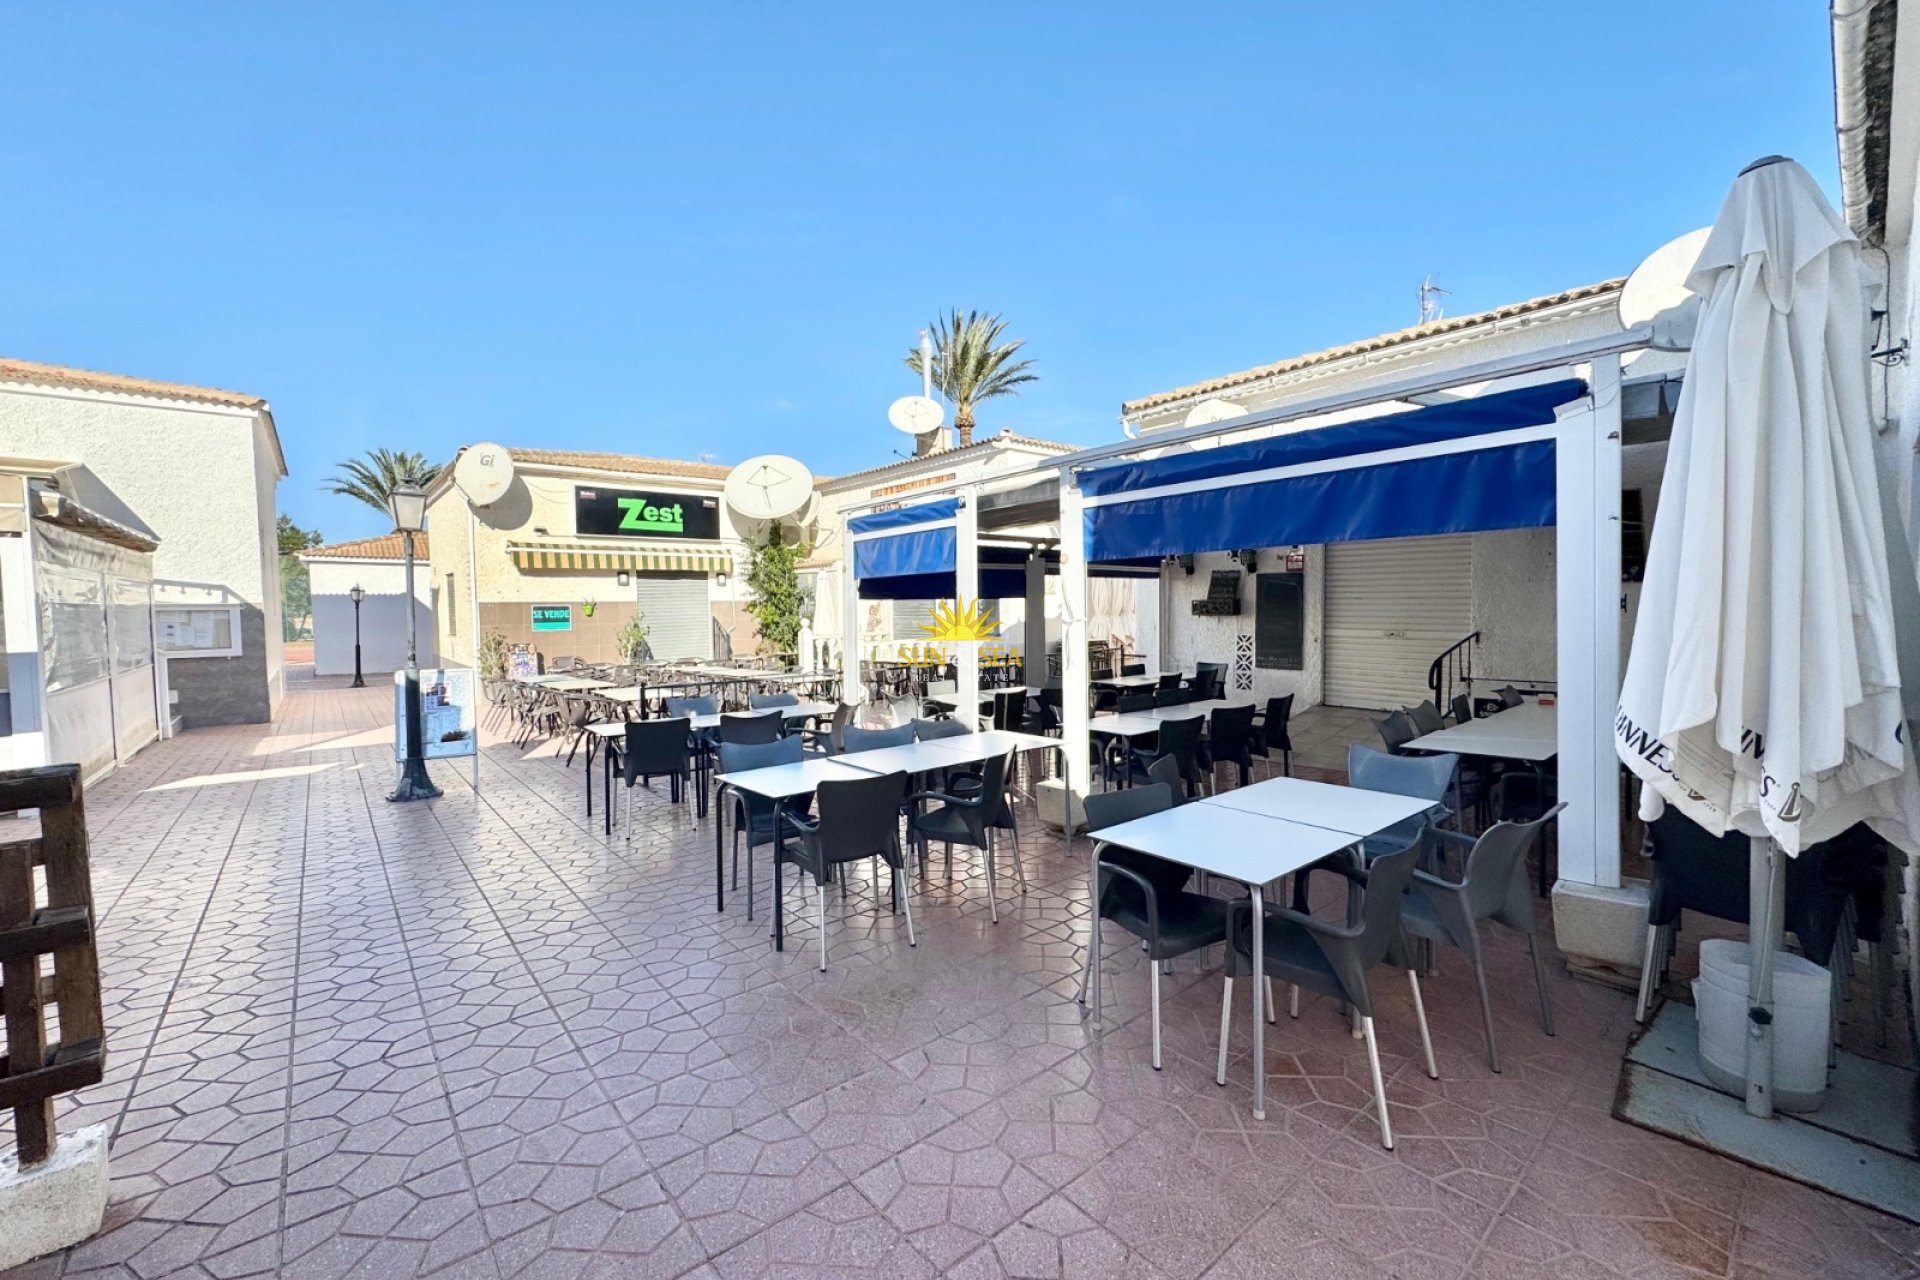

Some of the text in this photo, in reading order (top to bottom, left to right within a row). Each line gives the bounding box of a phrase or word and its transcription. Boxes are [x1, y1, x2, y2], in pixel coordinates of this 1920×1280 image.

[618, 498, 683, 532] Zest
[533, 609, 570, 618] SE VENDE
